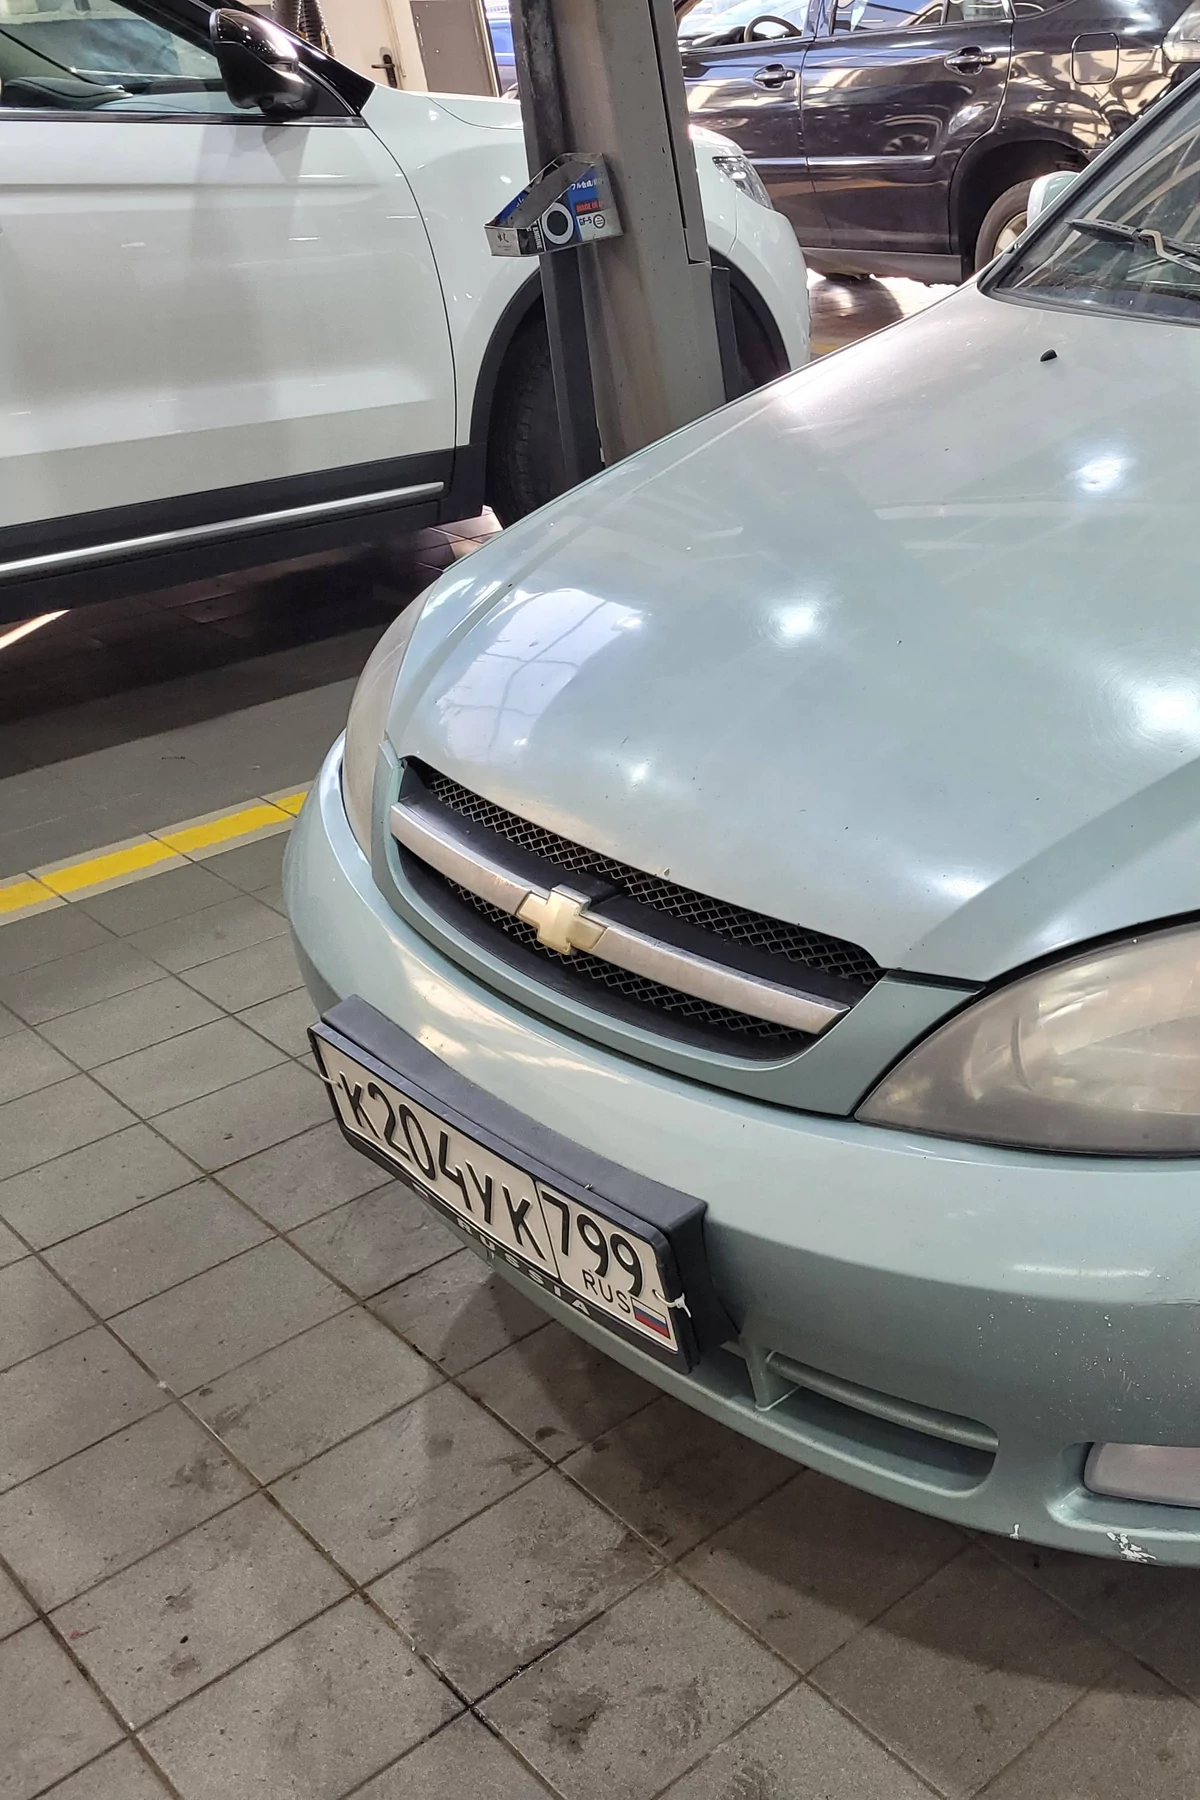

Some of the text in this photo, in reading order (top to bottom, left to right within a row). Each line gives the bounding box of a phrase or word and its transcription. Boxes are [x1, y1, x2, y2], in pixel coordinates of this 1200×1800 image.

[579, 216, 592, 226] GF-5
[456, 1217, 591, 1316] RUSSIA
[541, 1193, 643, 1298] 799
[582, 1269, 632, 1315] RUS
